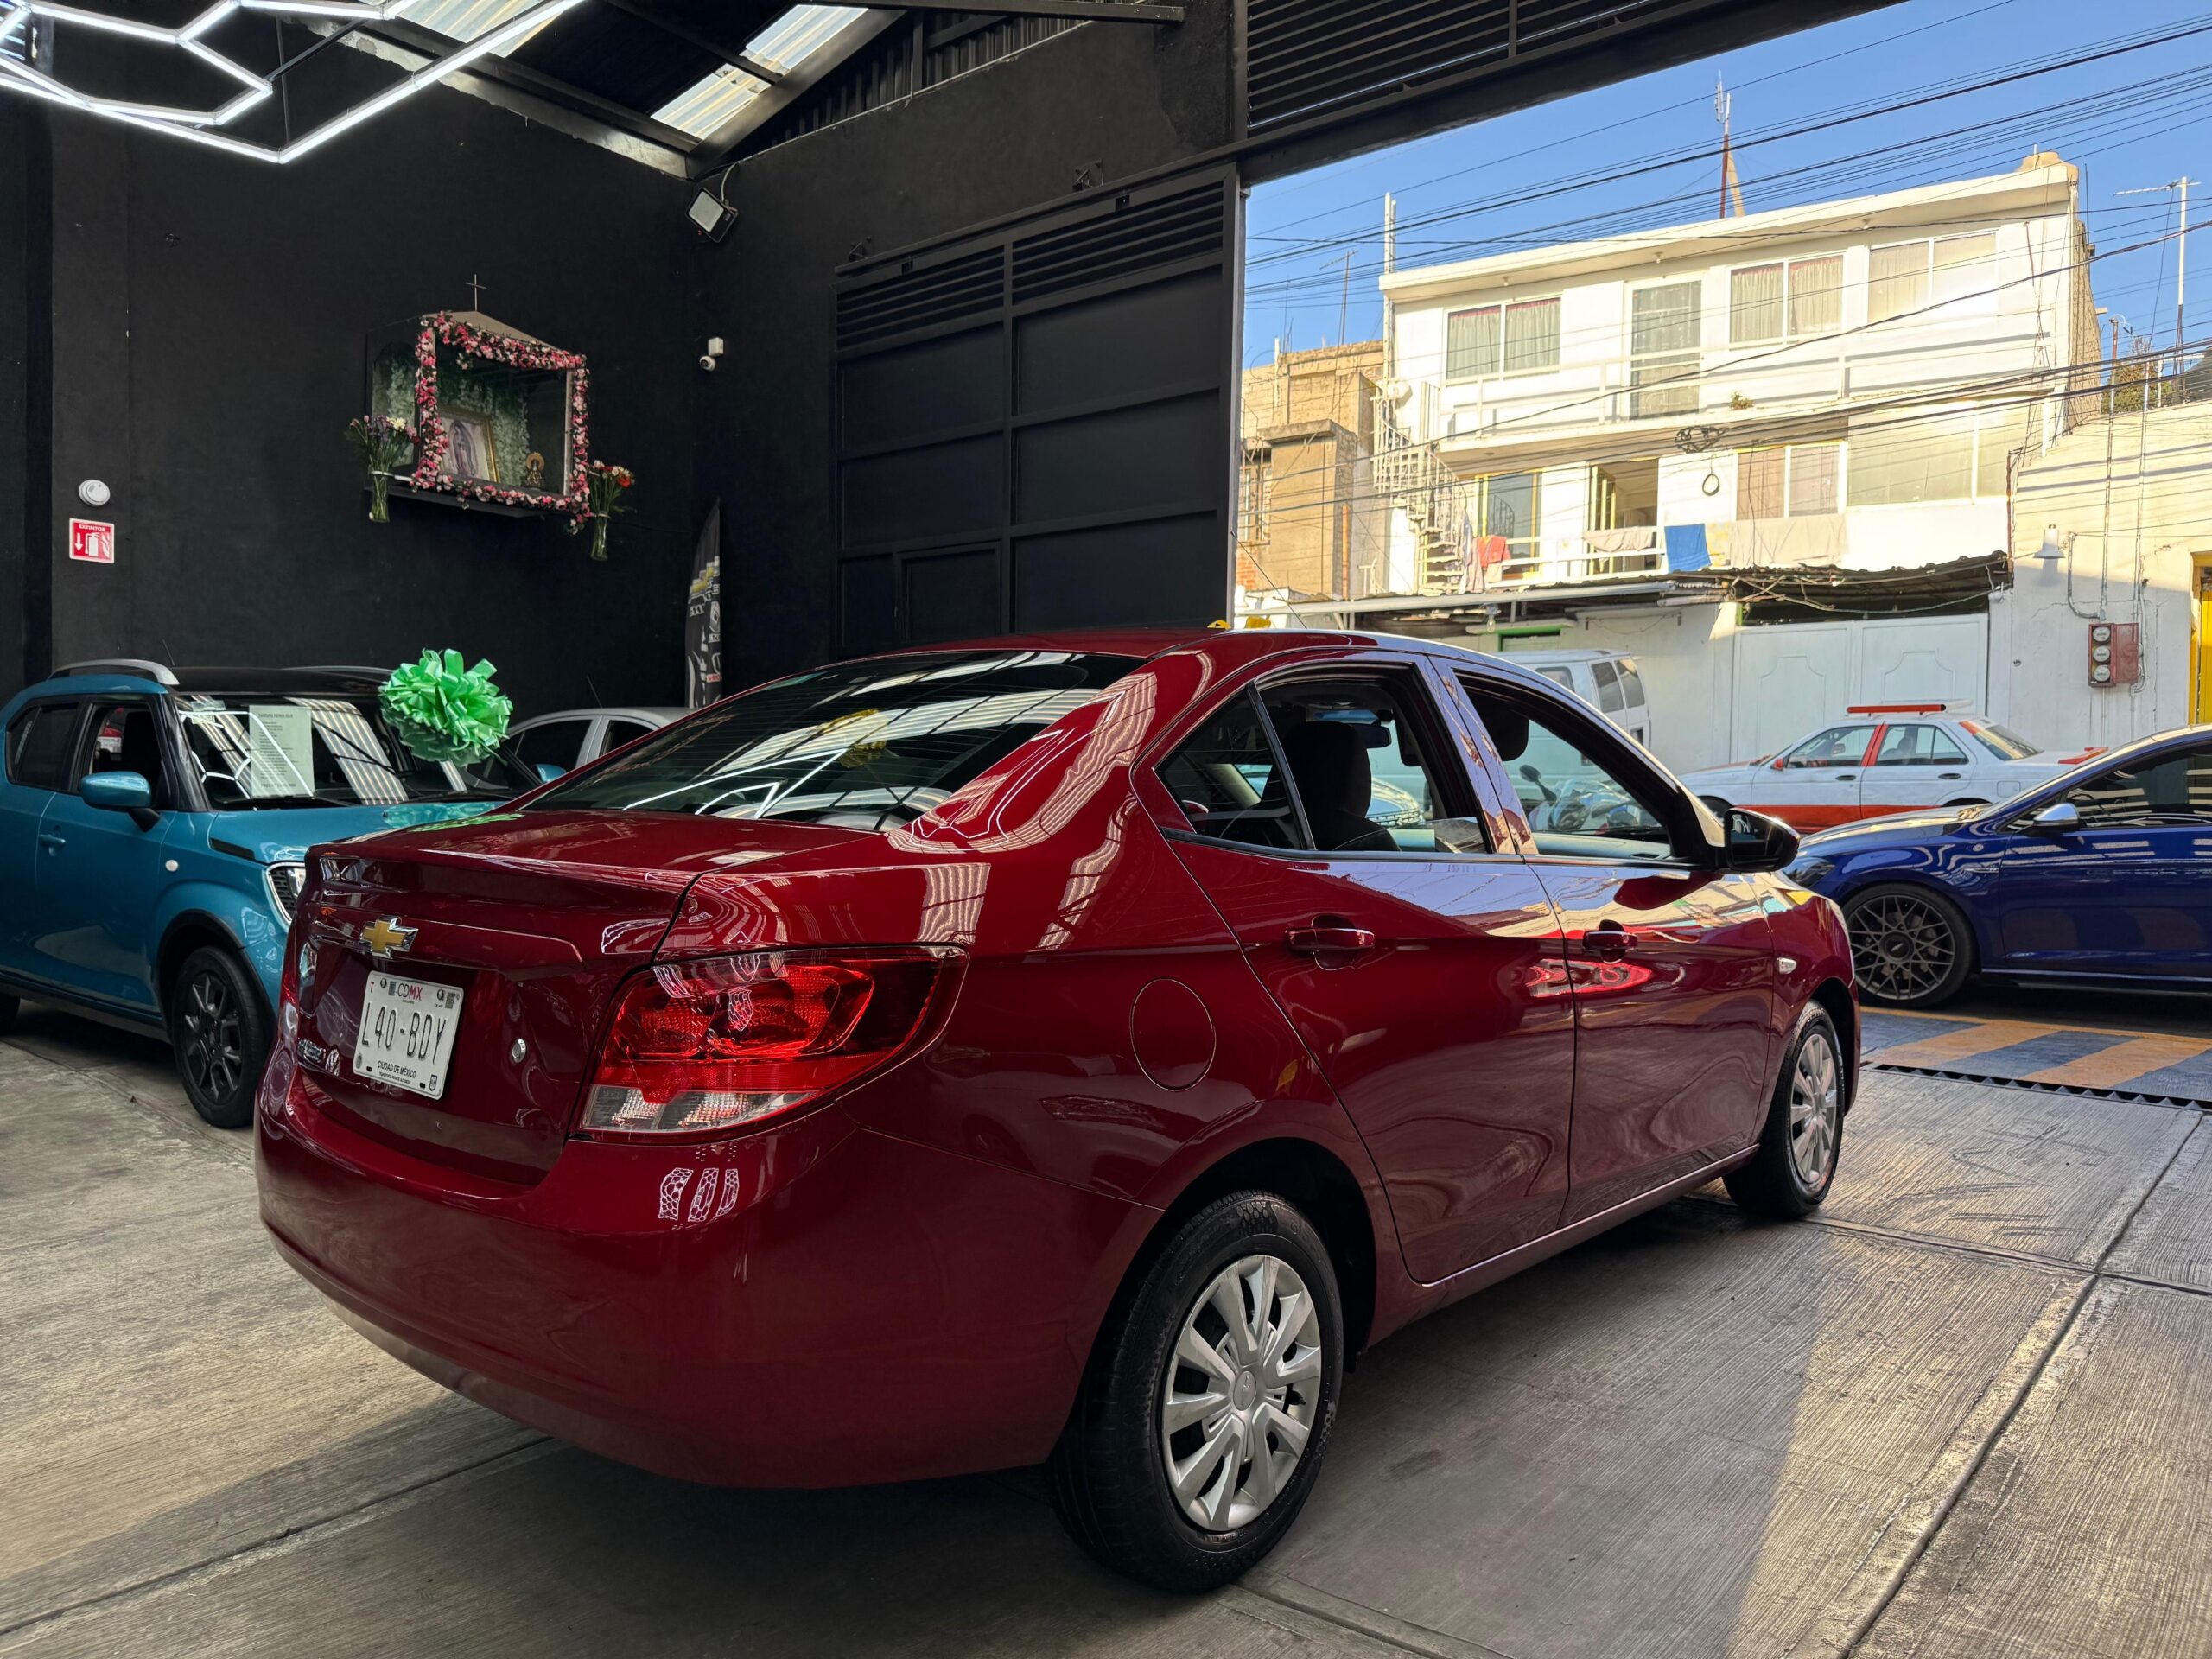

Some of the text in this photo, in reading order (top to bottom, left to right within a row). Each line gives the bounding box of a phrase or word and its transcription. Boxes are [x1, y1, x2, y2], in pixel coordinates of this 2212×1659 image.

[397, 982, 423, 1001] CDMX
[362, 1001, 447, 1065] L40-BDY
[377, 1060, 394, 1071] CIUDAD
[393, 1065, 400, 1074] DE
[399, 1065, 416, 1079] MÉXICO
